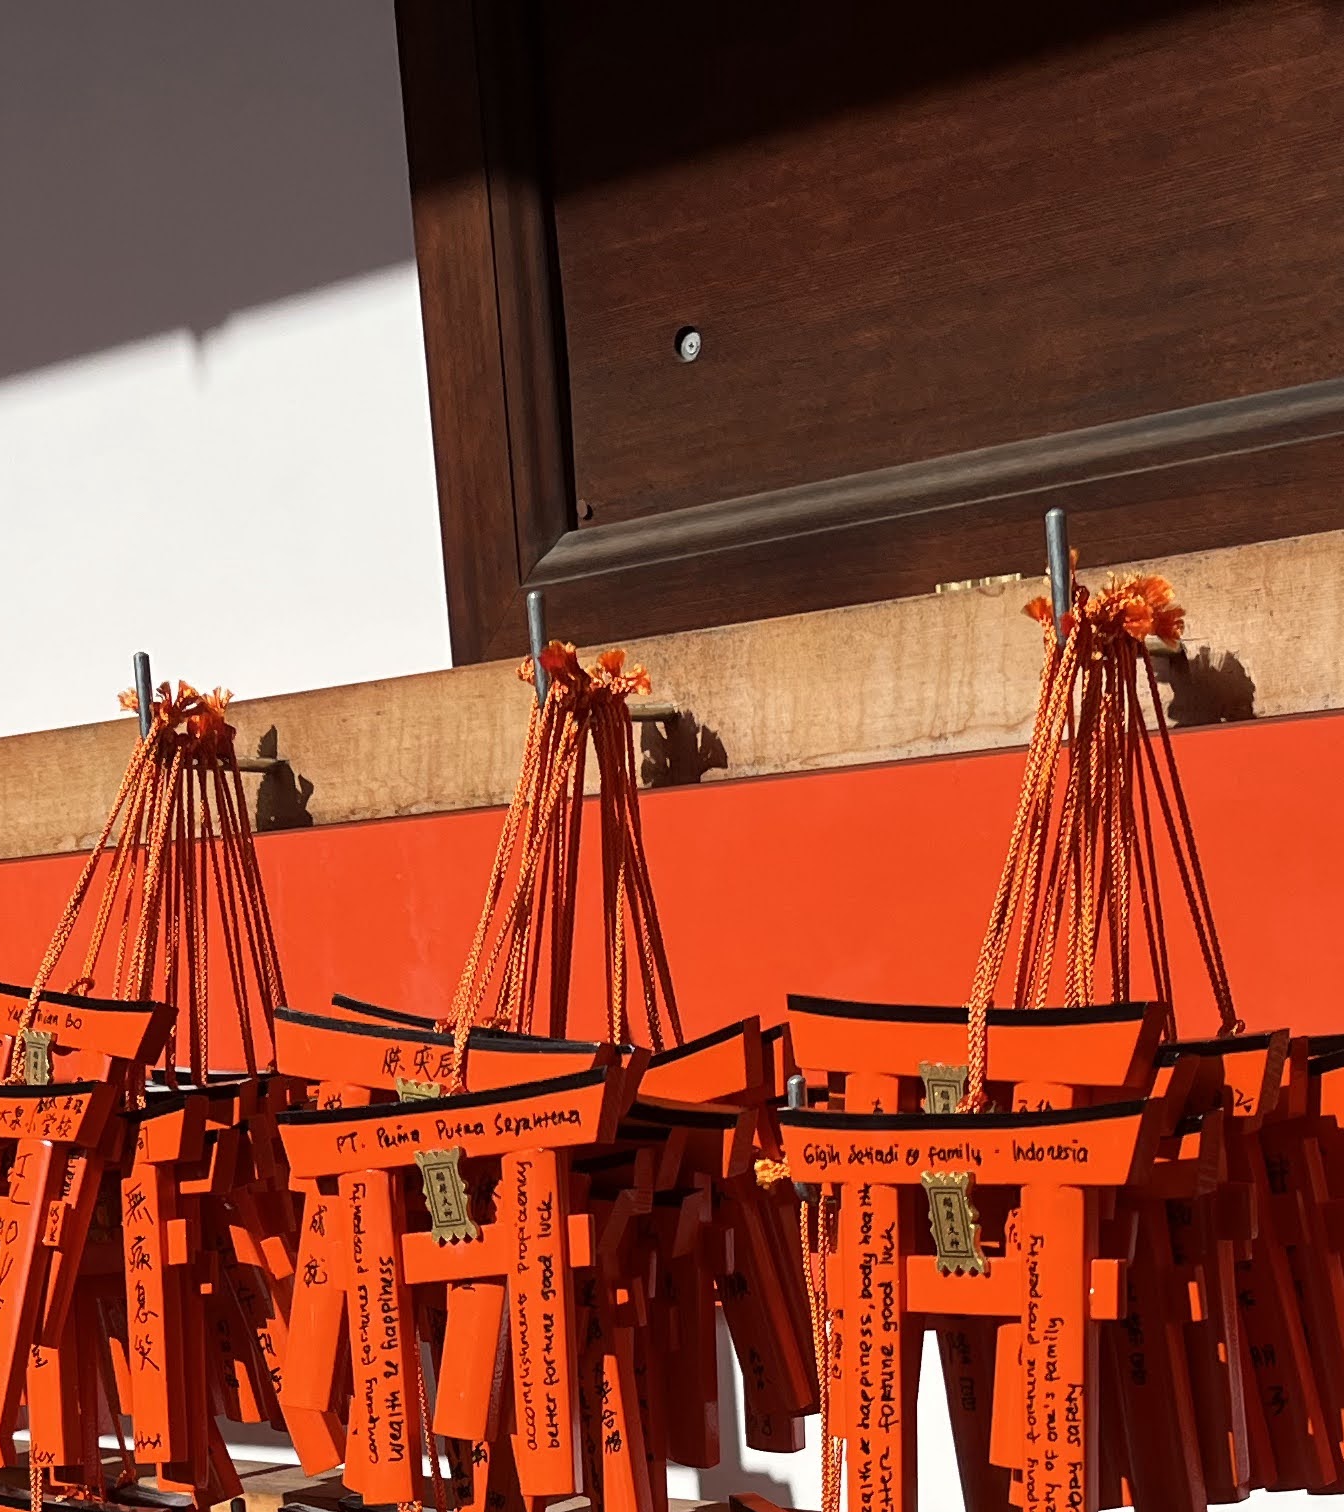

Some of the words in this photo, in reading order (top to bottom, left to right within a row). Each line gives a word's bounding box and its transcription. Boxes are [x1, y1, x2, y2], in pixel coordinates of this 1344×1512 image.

[927, 1142, 984, 1168] family
[1012, 1138, 1088, 1163] Indonesia
[878, 1222, 895, 1266] luck
[537, 1254, 556, 1301] good
[857, 1252, 876, 1300] body
[878, 1280, 897, 1332] good
